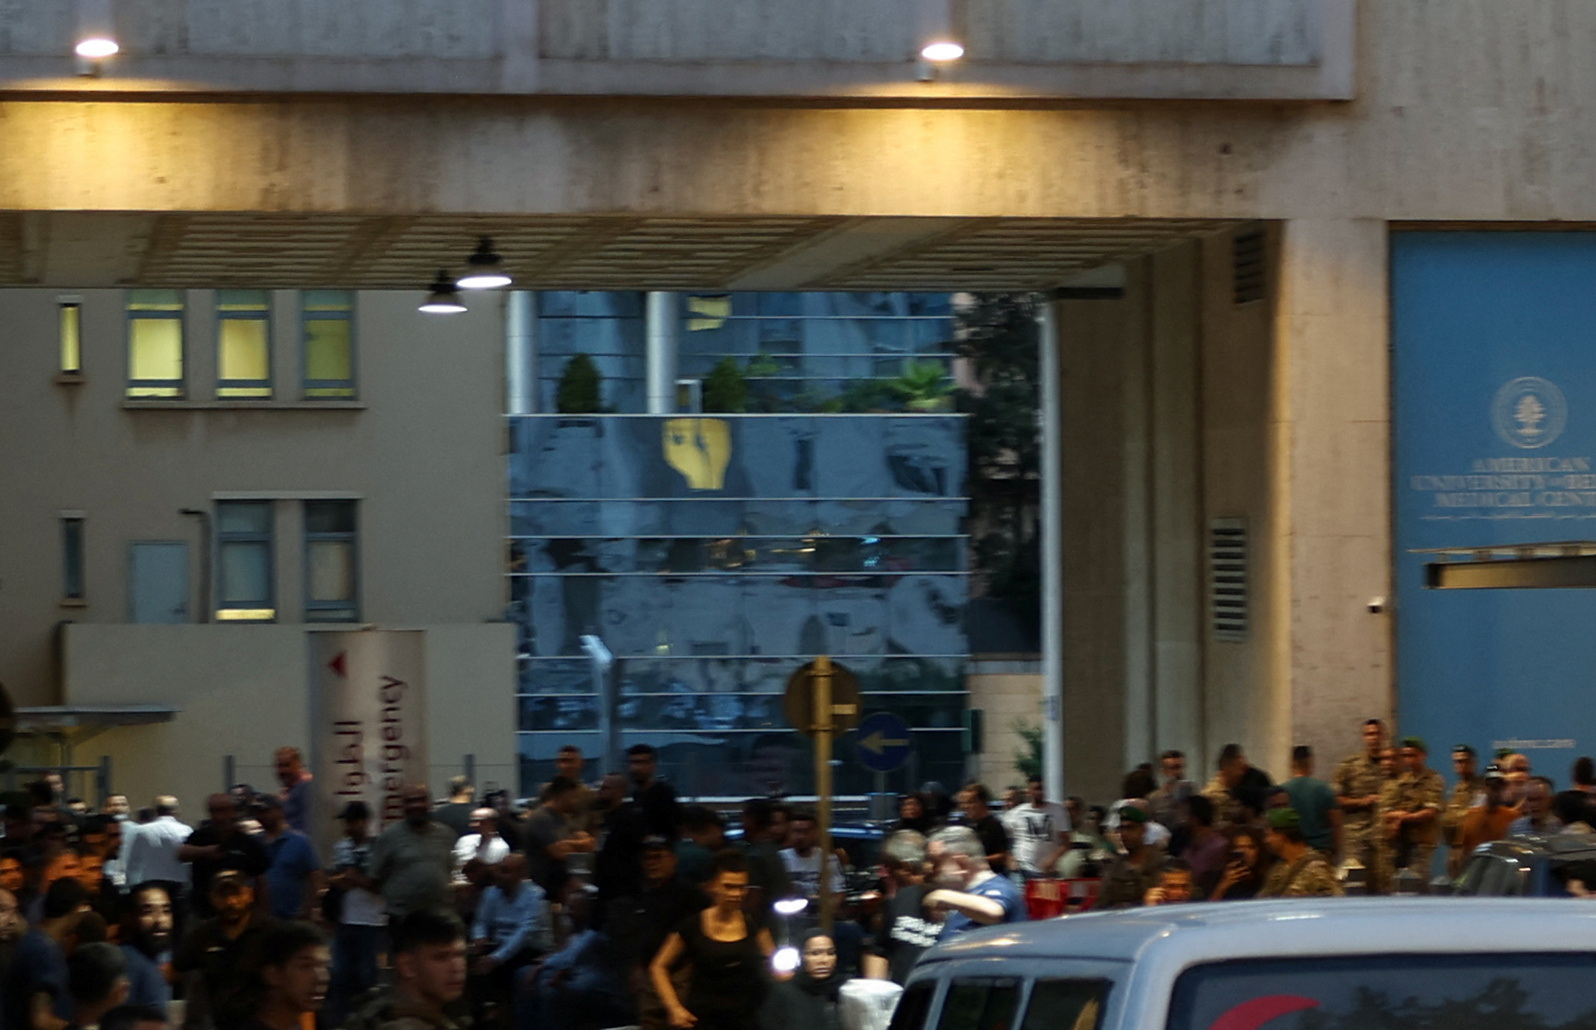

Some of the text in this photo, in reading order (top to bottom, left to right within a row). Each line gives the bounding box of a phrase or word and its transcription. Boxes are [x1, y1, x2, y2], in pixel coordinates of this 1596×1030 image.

[1472, 457, 1591, 472] AMERICAN
[1411, 474, 1547, 490] UNIVERSITY
[1434, 491, 1533, 507] MEDICAL
[378, 673, 409, 828] mergency
